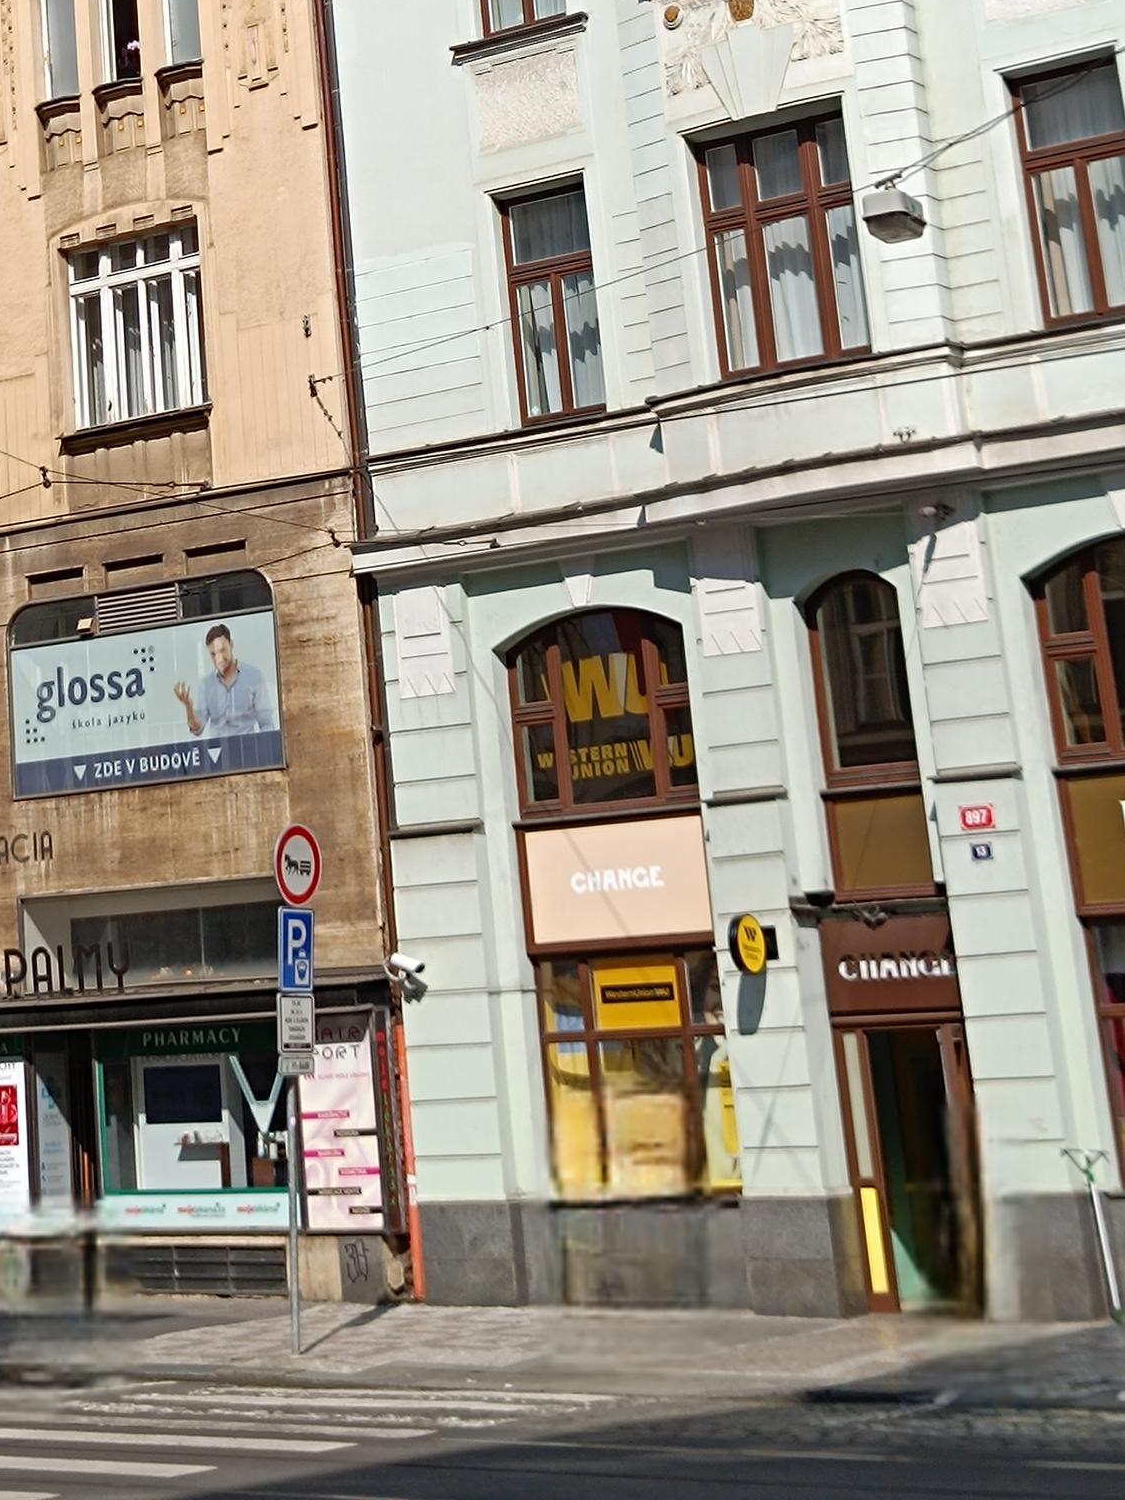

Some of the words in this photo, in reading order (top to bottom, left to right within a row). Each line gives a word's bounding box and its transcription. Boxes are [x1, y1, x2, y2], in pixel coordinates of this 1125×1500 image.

[36, 666, 146, 723] glossa
[72, 713, 102, 729] škola
[93, 759, 122, 779] ZDE
[124, 758, 135, 775] V
[139, 747, 201, 773] BUDOVĚ
[537, 742, 628, 769] WSTERN
[965, 808, 988, 824] 897
[975, 845, 987, 857] 13
[570, 865, 665, 894] CHANGE
[287, 918, 307, 966] P
[4, 940, 130, 999] PALMY
[142, 1027, 242, 1047] PHARMACY
